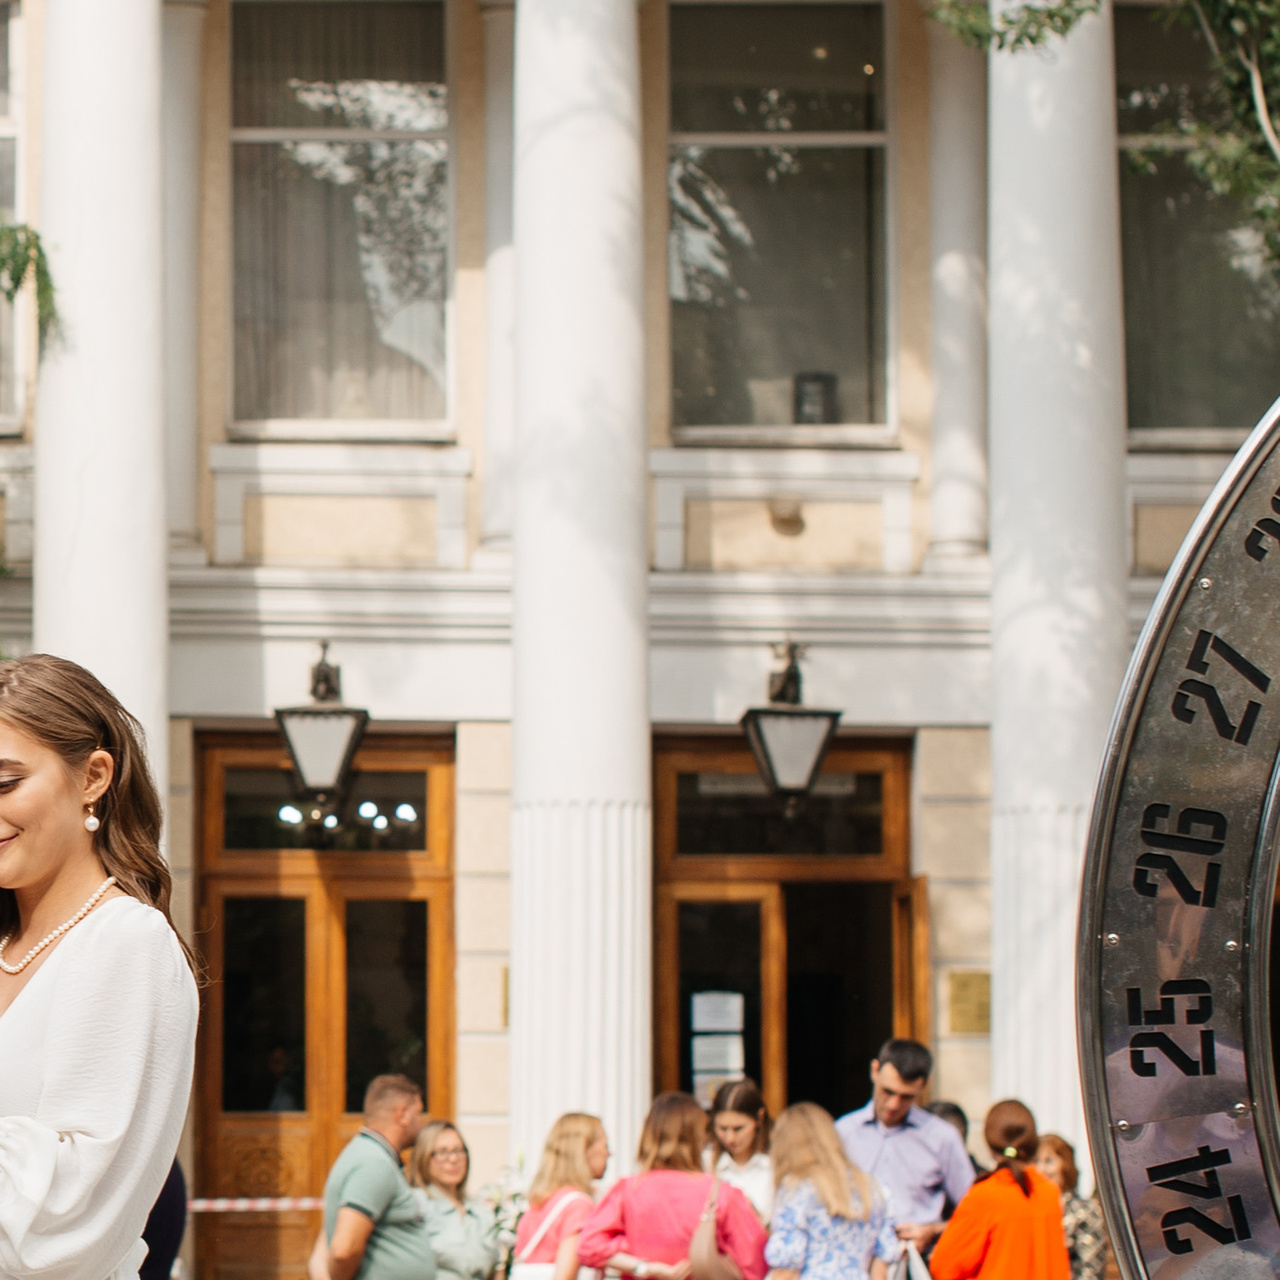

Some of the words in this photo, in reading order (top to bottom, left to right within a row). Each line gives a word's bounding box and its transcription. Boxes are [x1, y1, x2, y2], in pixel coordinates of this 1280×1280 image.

[1171, 628, 1272, 747] 27
[1132, 802, 1227, 908] 26
[1127, 978, 1216, 1078] 25
[1145, 1144, 1253, 1256] 24
